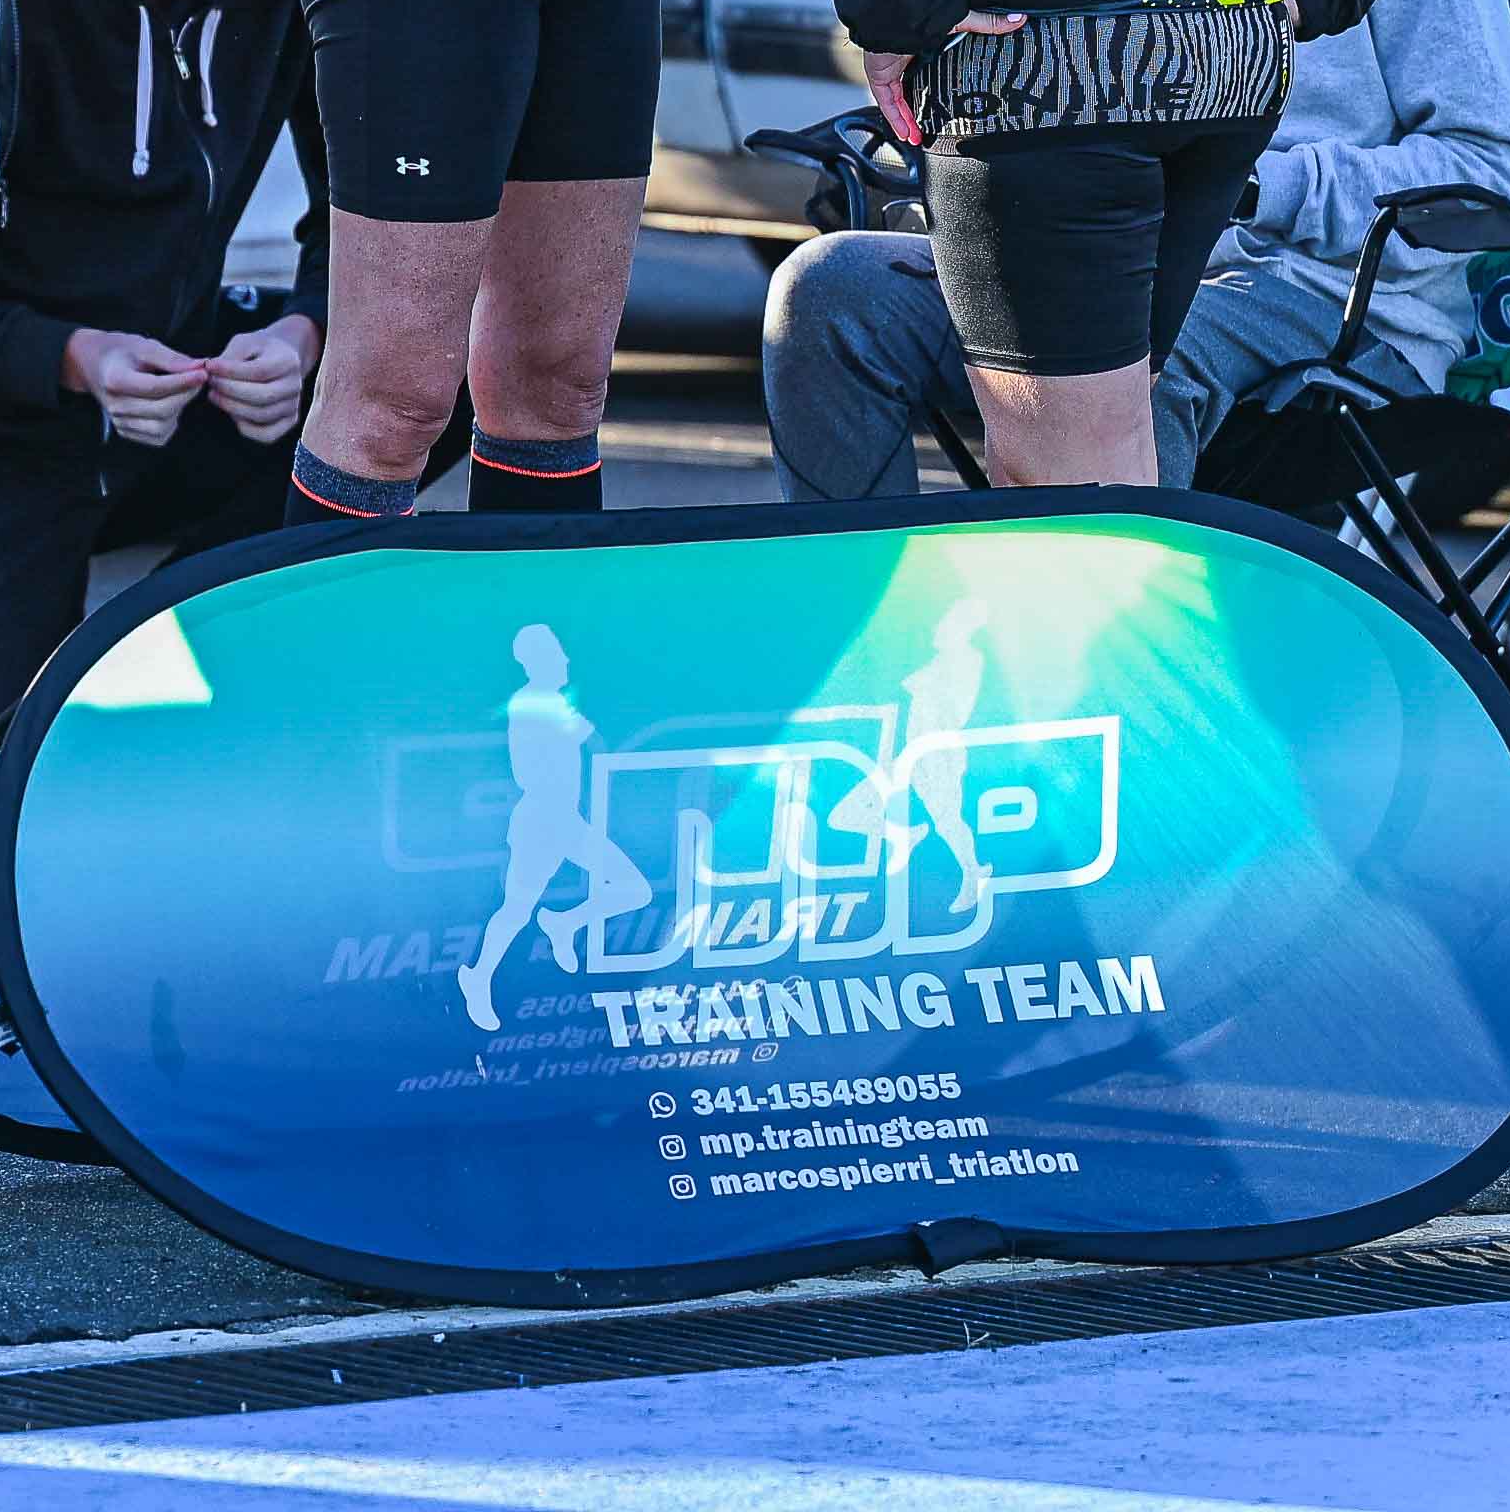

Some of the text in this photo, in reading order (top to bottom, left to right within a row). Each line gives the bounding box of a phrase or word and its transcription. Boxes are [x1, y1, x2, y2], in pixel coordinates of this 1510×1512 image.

[592, 954, 1168, 1049] TRAINING TEAM
[691, 1072, 962, 1116] 341-155489055
[699, 1113, 989, 1159] mp.trainingteam
[710, 1148, 1080, 1196] marcospierri_triatlon
